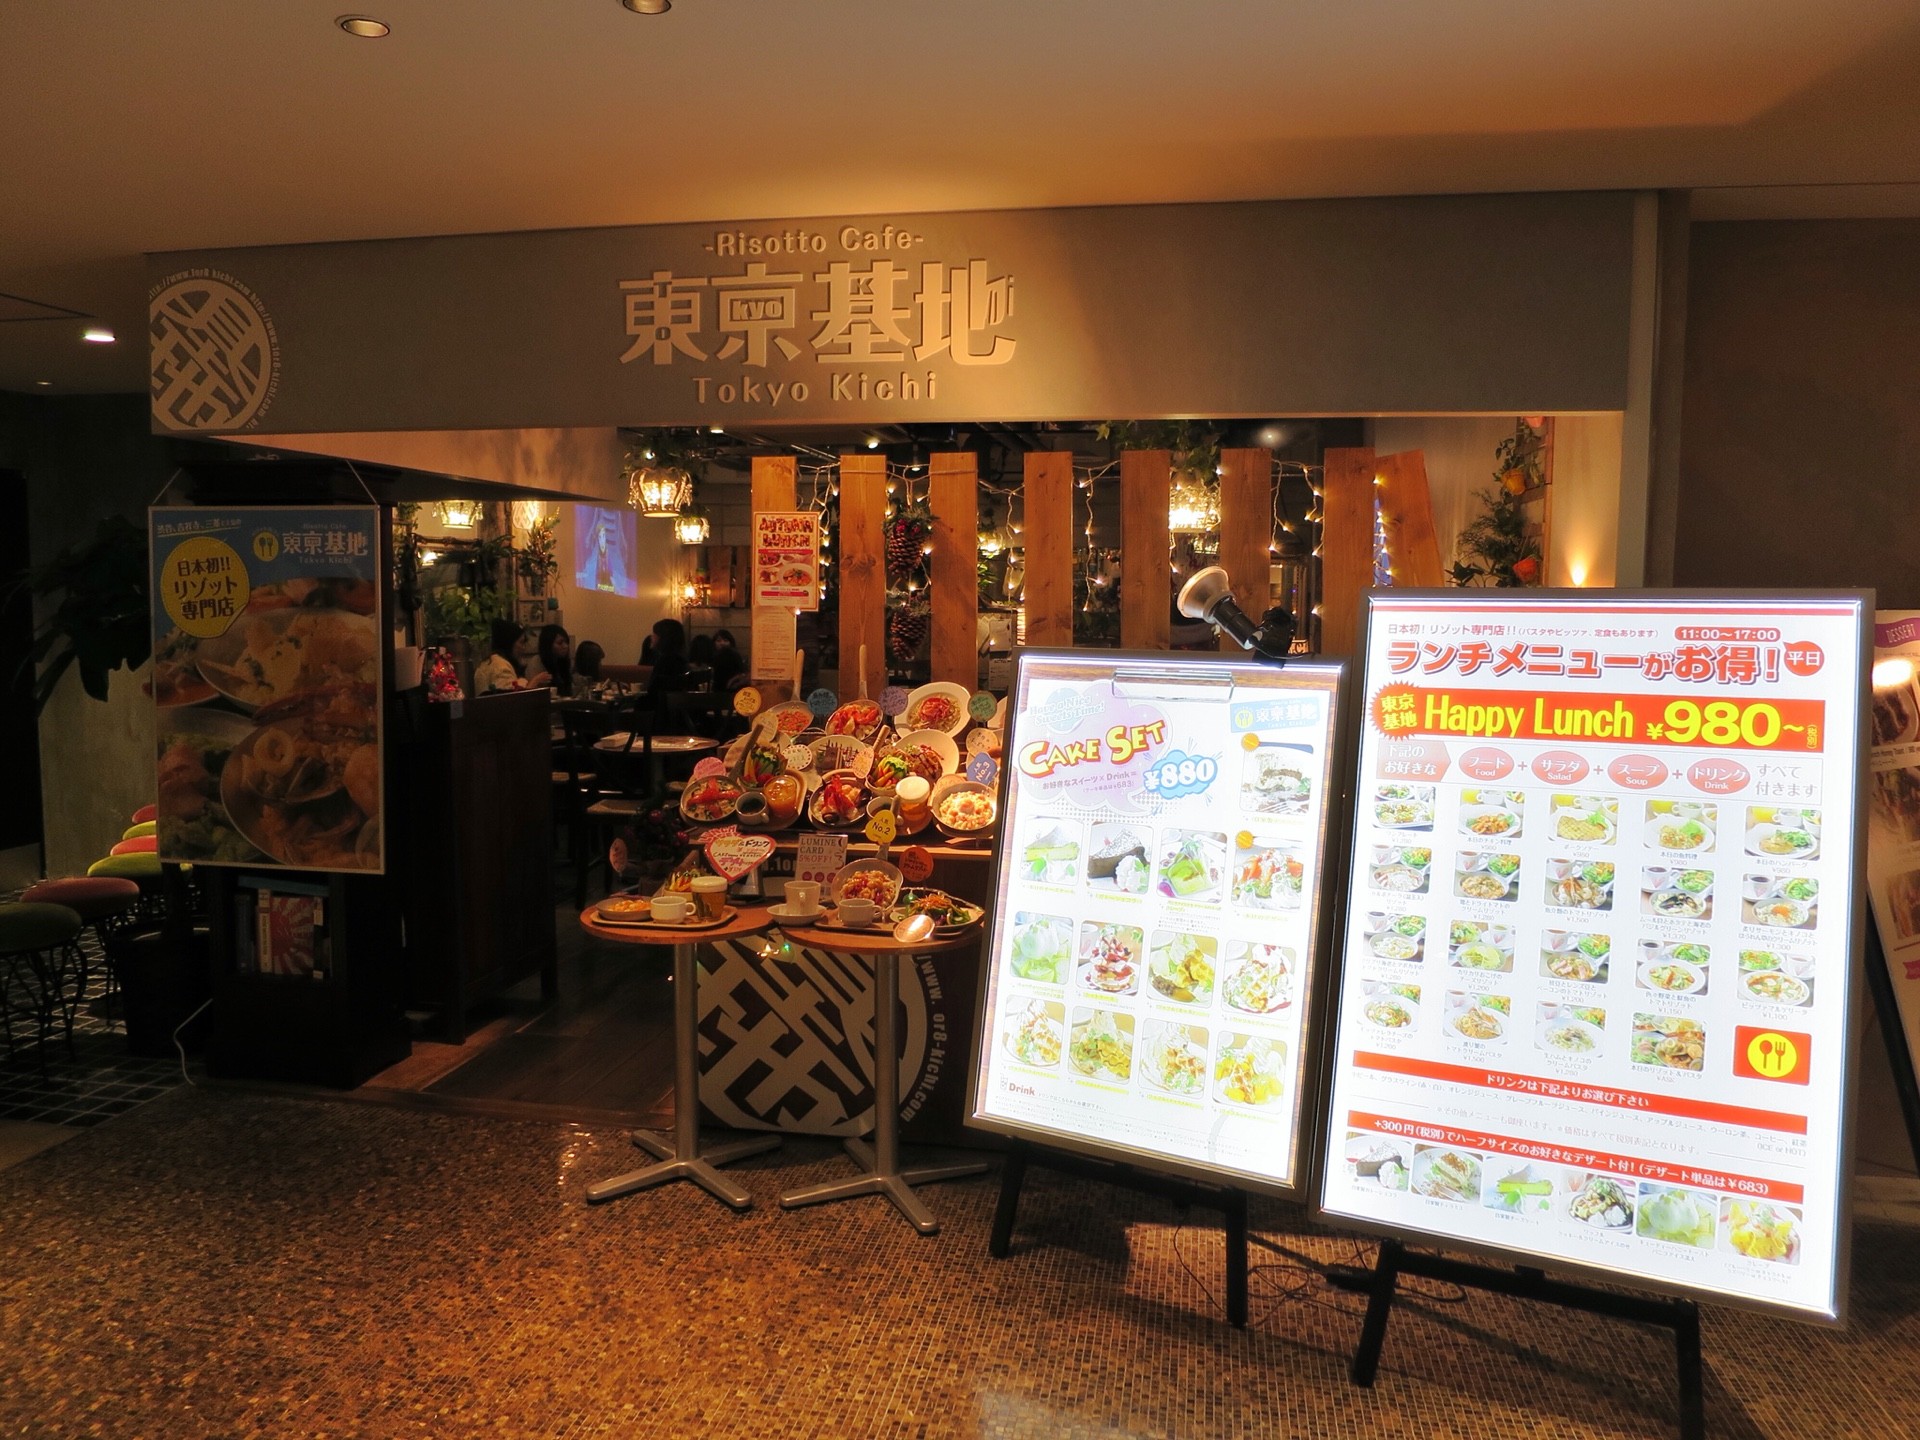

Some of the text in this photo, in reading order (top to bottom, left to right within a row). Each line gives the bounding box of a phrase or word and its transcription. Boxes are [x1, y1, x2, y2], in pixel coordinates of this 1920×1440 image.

[618, 258, 1017, 367] 東京基地
[692, 370, 937, 407] Tokyo Kichi
[282, 530, 368, 556] 東京基地
[173, 576, 238, 600] リゾット
[180, 597, 234, 621] 専門店
[1886, 623, 1917, 643] DESSERT
[1786, 650, 1822, 667] 平日
[1382, 693, 1416, 712] 東京
[1383, 711, 1418, 730] 基地
[1425, 694, 1524, 738] Happy
[1534, 698, 1633, 738] Lunch
[1018, 719, 1165, 778] CAKE SET
[1387, 744, 1425, 758] 下記の
[1384, 760, 1437, 776] お好きな
[1468, 755, 1506, 769] フード
[1540, 759, 1582, 773] サラダ
[1618, 763, 1660, 776] スープ
[975, 761, 991, 781] No.3
[1143, 757, 1218, 793] ¥880
[1475, 768, 1496, 777] Food
[1547, 772, 1572, 782] Salad
[1693, 766, 1747, 782] ドリンク
[1757, 763, 1803, 780] すべて
[1625, 776, 1648, 787] Soup
[1704, 781, 1729, 790] Drink
[1755, 780, 1818, 798] 付きます
[872, 822, 891, 835] No.2
[800, 846, 824, 854] CARD
[801, 838, 838, 846] LUMINE
[1008, 1082, 1036, 1098] Drink
[1487, 1073, 1649, 1107] ドリンクは下記よりお選び下さい
